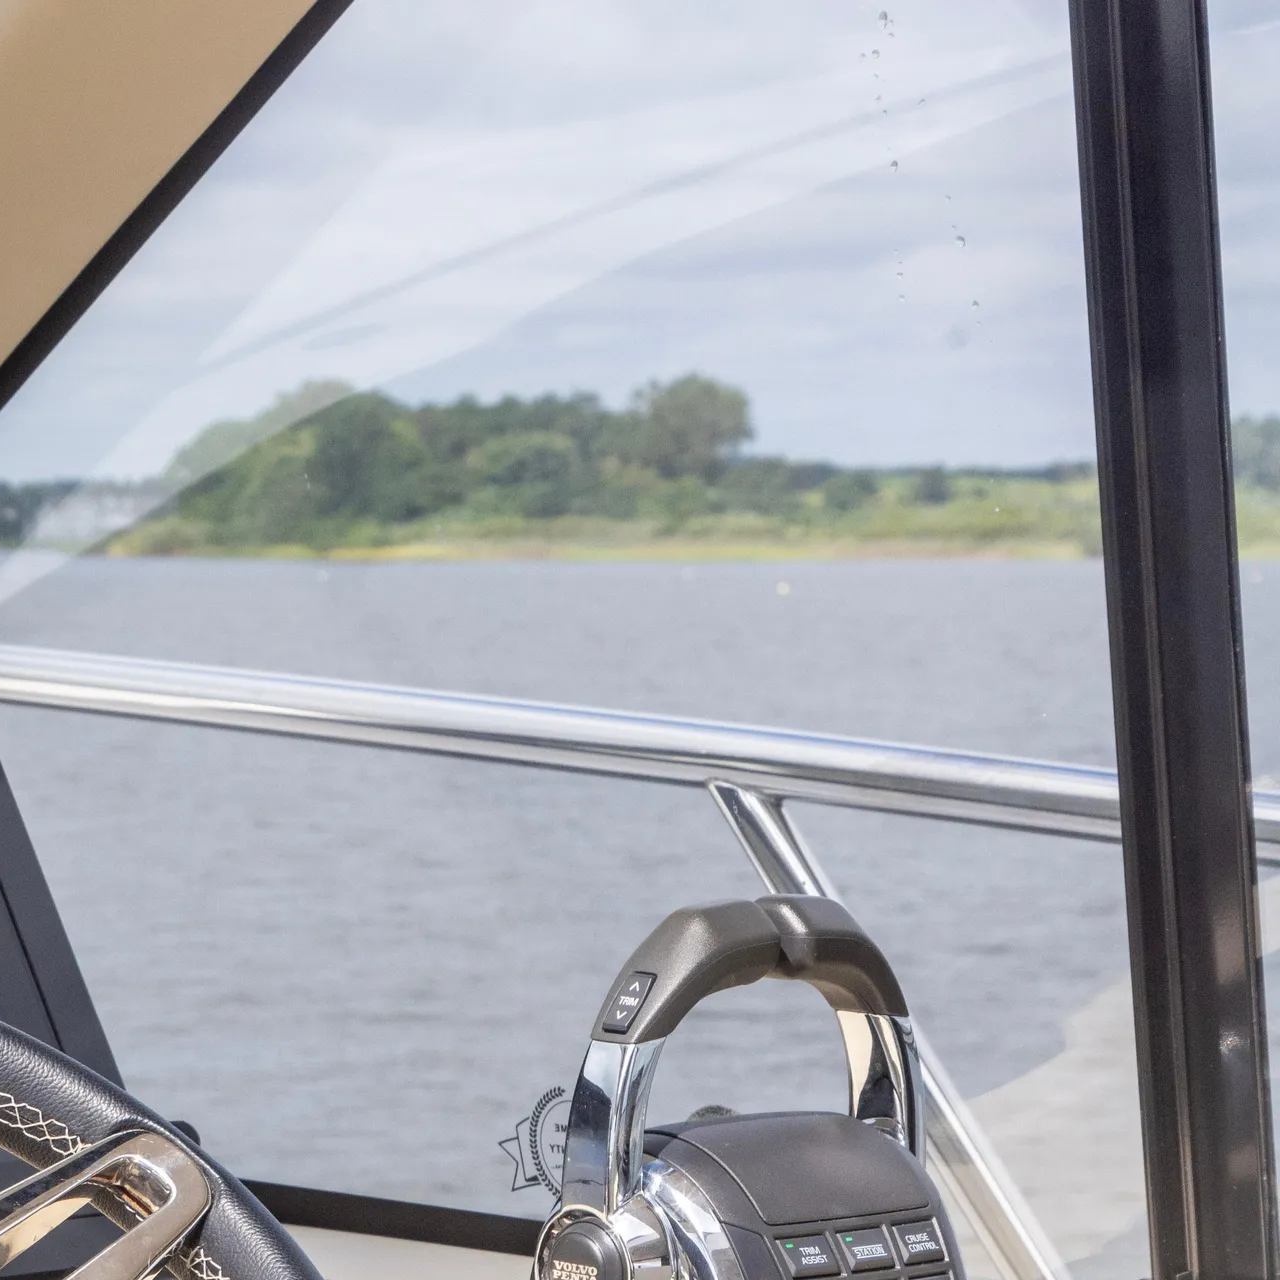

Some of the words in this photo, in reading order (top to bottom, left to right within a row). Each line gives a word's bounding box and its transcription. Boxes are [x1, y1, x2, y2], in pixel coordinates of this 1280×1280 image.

[619, 995, 640, 1007] TRIM
[905, 1233, 930, 1244] CRUISE
[799, 1246, 821, 1256] TRIM
[853, 1247, 886, 1257] STATION
[908, 1242, 939, 1253] CONTROL
[801, 1254, 828, 1265] ASSIST
[552, 1259, 598, 1276] VOLVO
